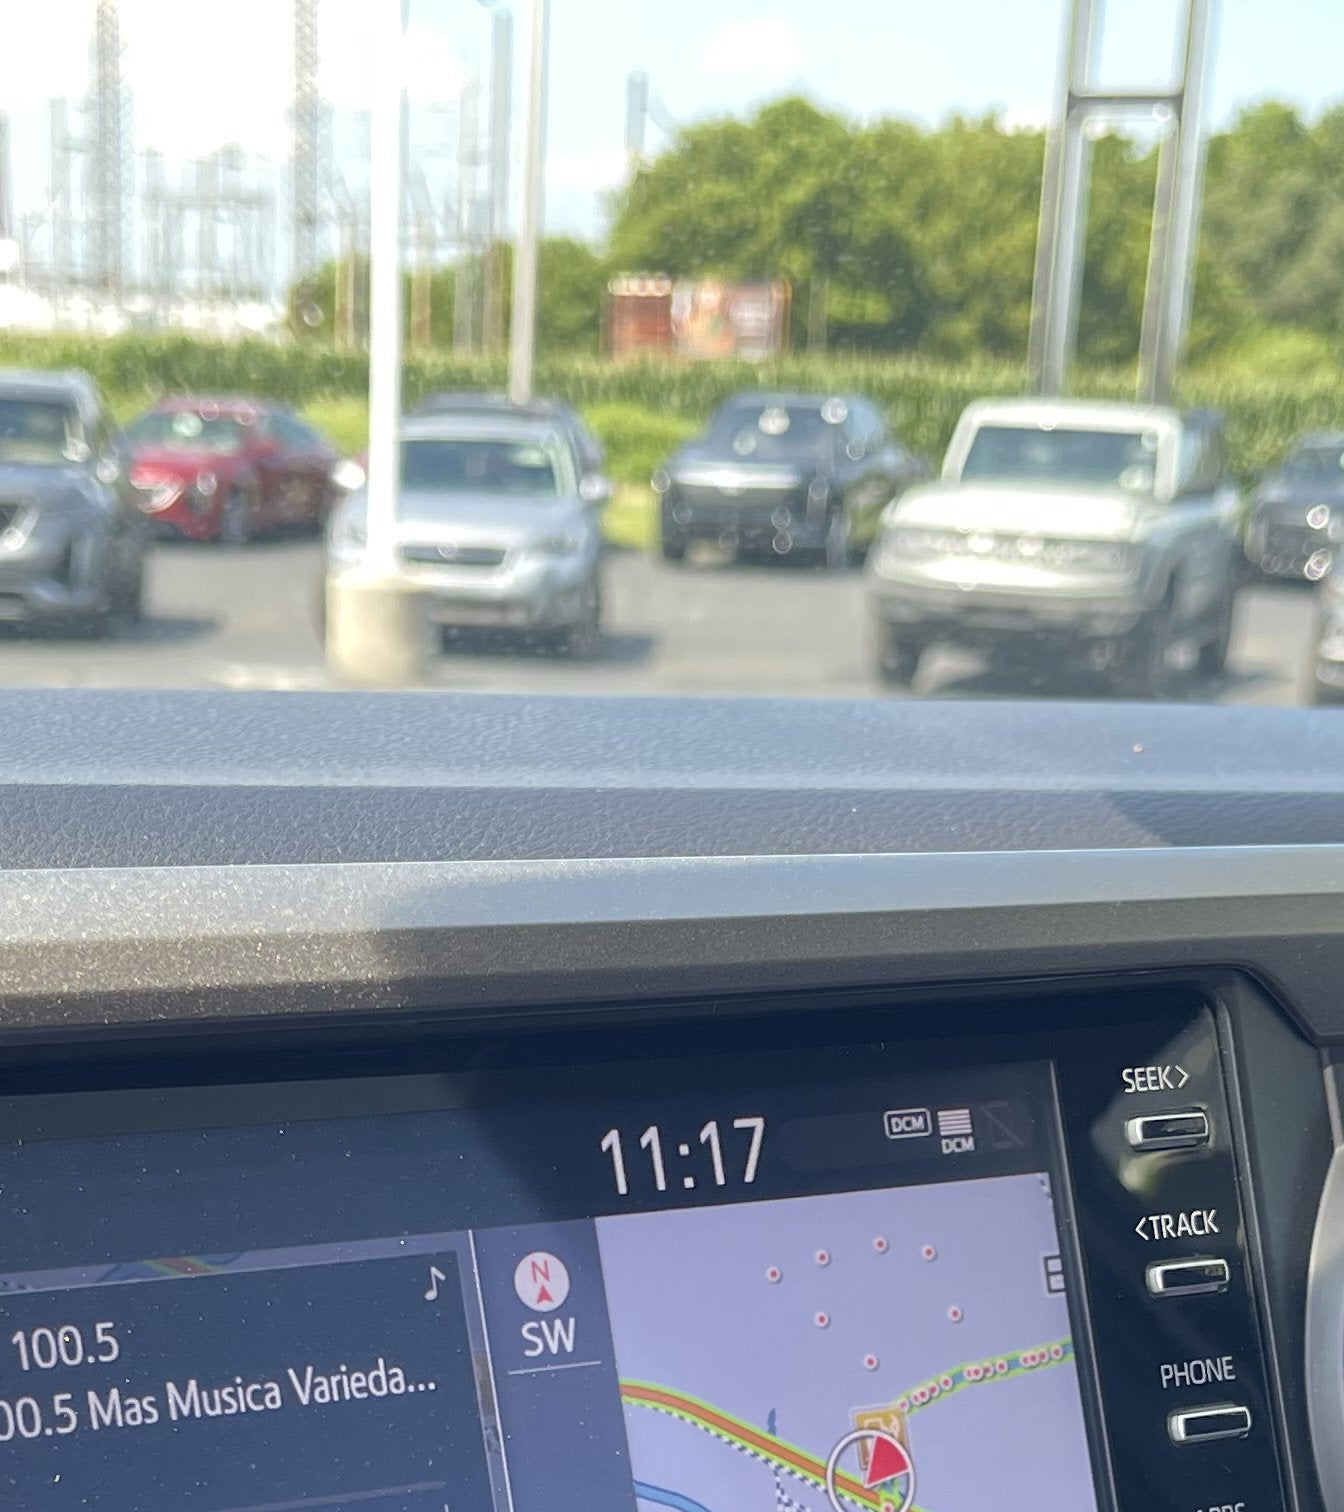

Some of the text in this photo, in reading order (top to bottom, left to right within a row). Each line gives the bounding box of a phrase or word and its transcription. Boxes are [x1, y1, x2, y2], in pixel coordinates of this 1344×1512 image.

[891, 1115, 926, 1133] DCM
[601, 1117, 766, 1196] 11:17
[941, 1136, 976, 1154] DCM
[11, 1321, 121, 1372] 100.5
[520, 1317, 577, 1358] SW
[1159, 1354, 1236, 1388] PHONE
[89, 1387, 160, 1431] Mas
[166, 1372, 283, 1421] Musica
